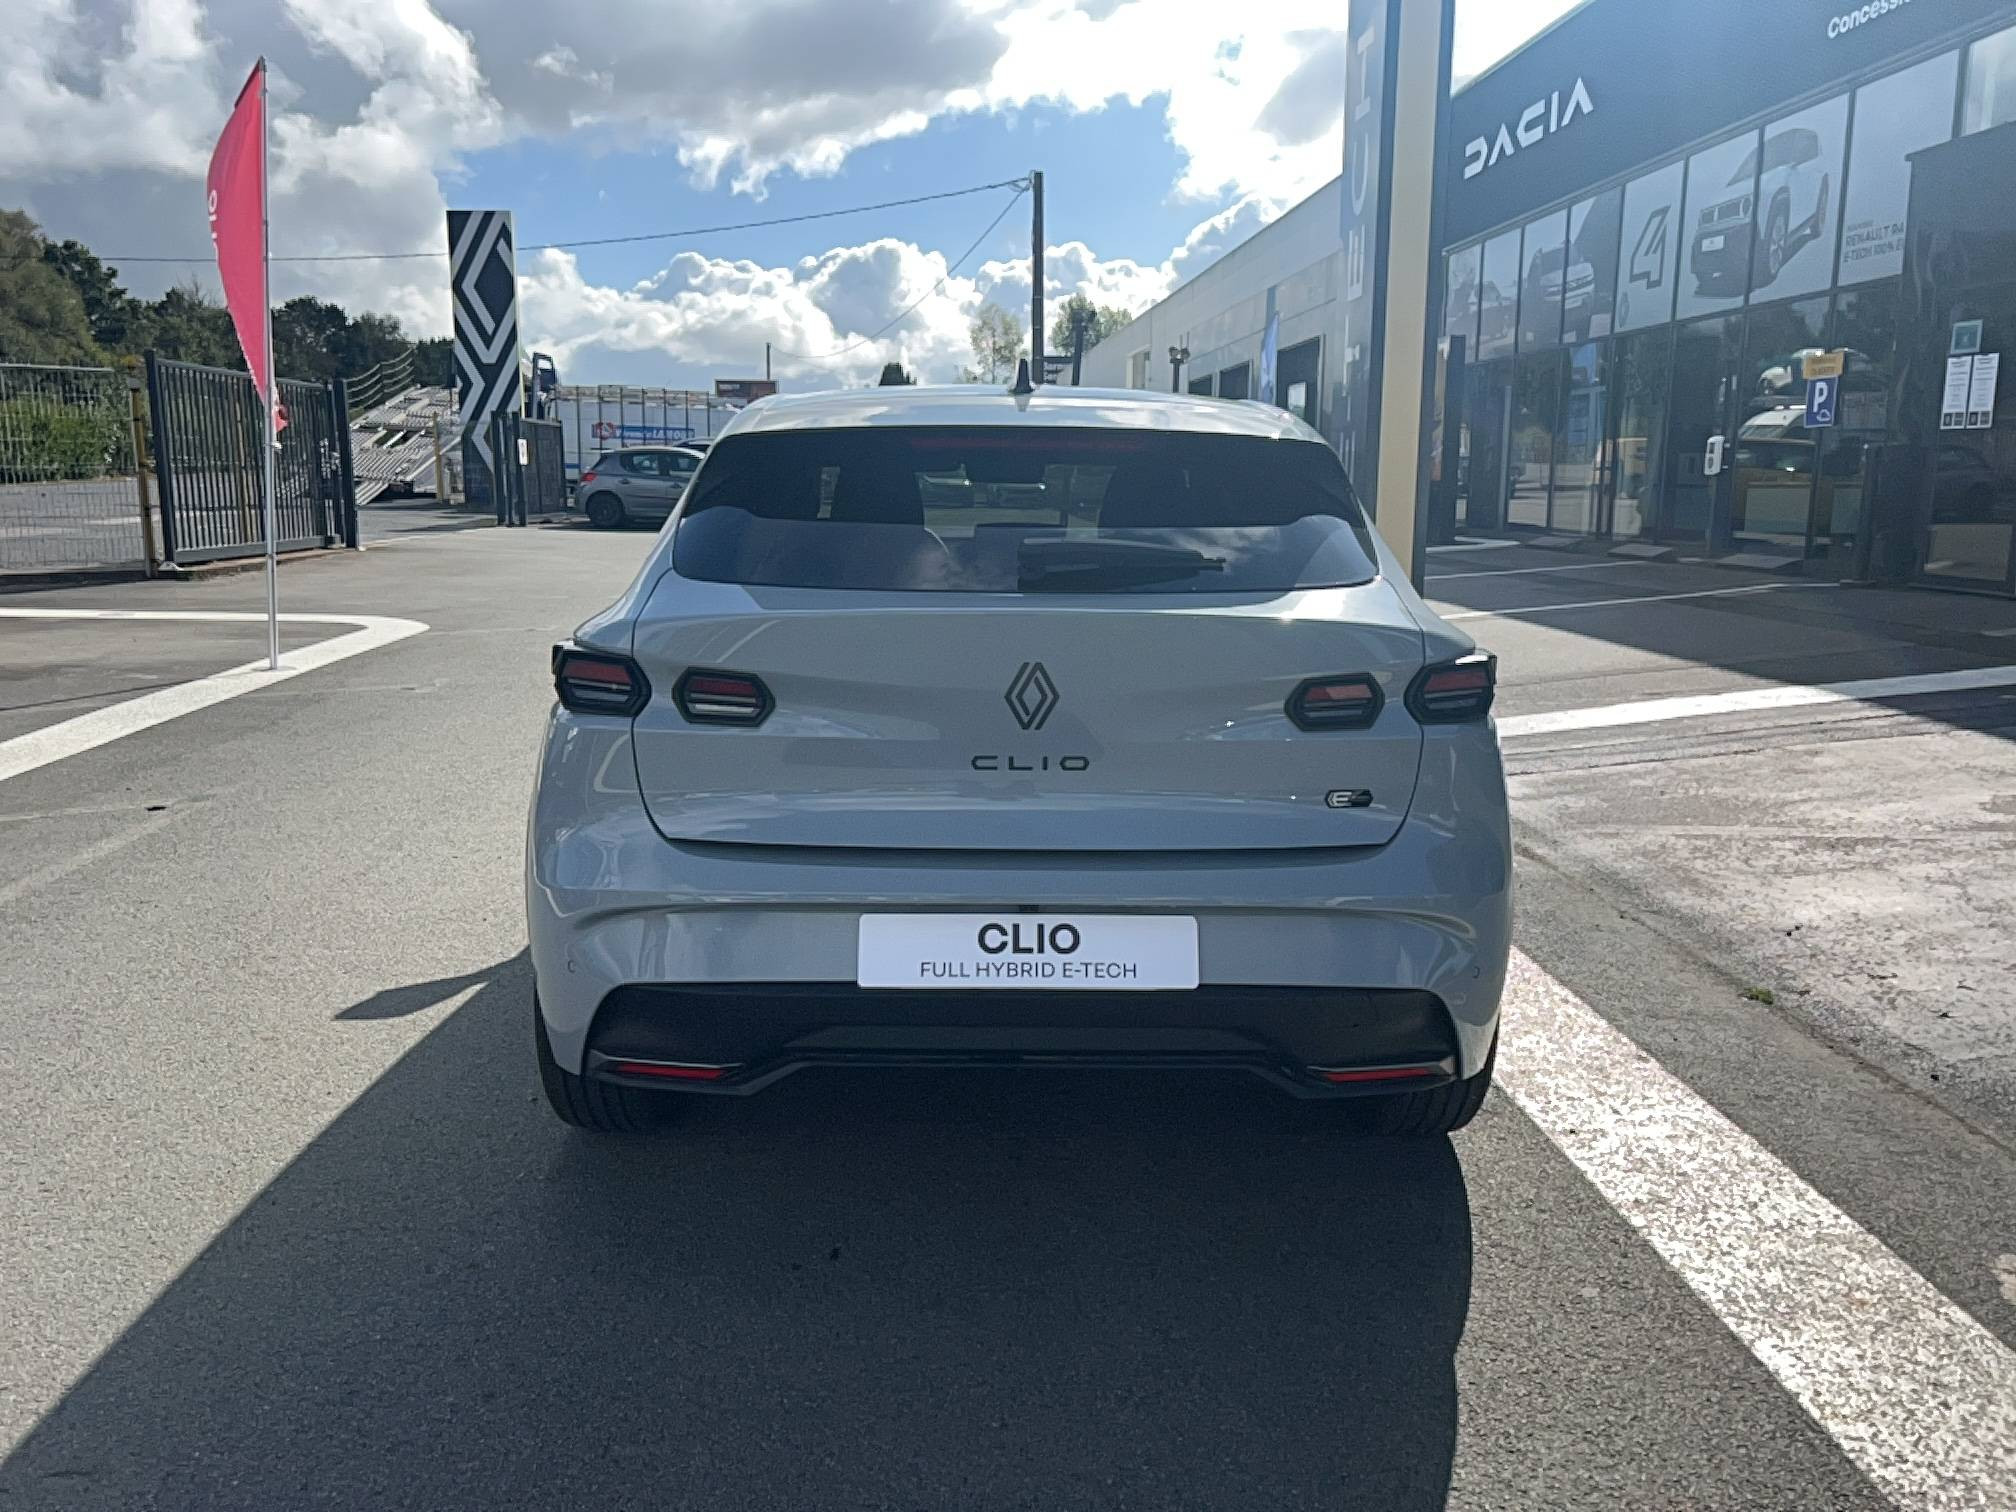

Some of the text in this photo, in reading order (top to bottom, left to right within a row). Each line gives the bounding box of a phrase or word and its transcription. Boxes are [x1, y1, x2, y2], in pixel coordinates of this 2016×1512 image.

[1464, 76, 1594, 180] DACIA
[1813, 381, 1828, 413] P
[971, 755, 1090, 771] CLIO
[977, 923, 1081, 954] CLIO
[920, 962, 1137, 979] FULL HYBRID E-TECH
